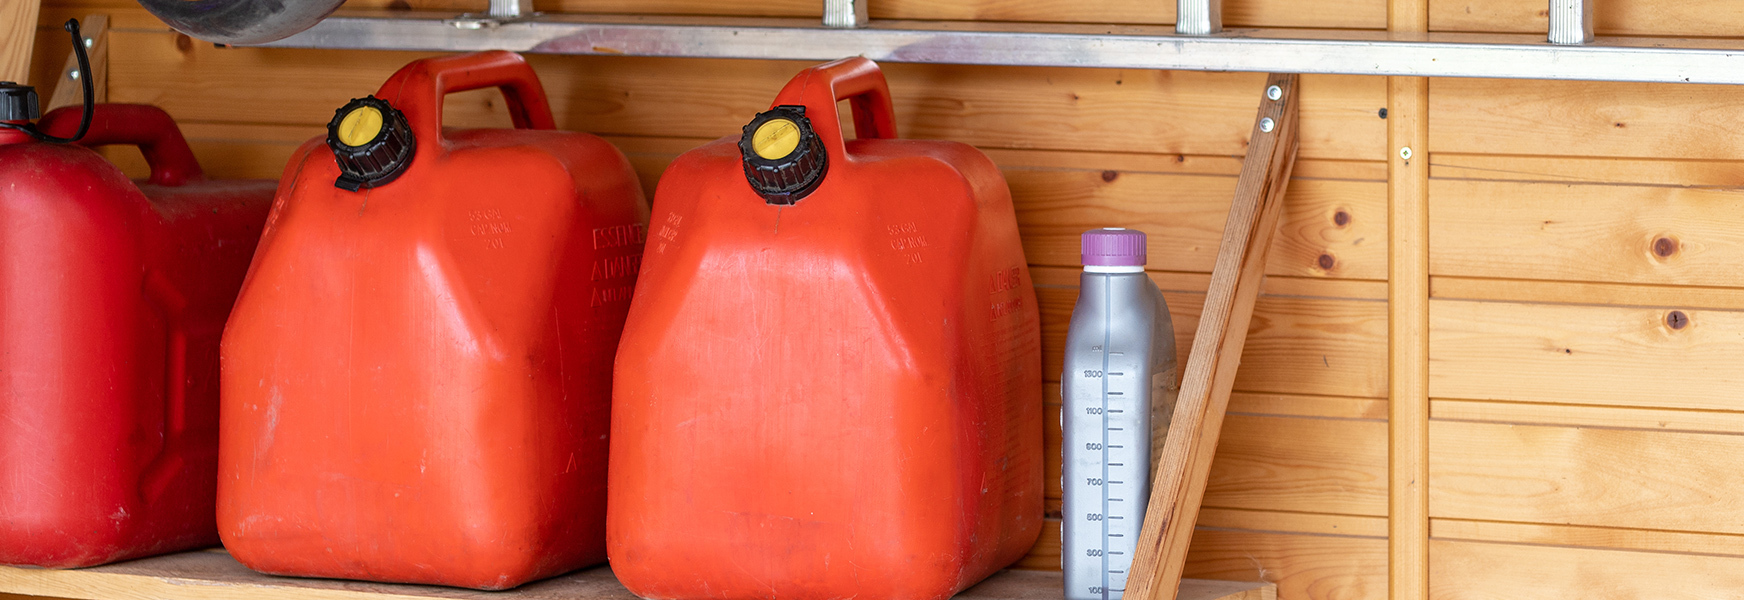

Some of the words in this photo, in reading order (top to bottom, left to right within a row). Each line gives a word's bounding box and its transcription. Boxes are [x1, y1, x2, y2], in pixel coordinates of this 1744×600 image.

[1083, 369, 1103, 379] 1300
[1085, 406, 1103, 416] 1100
[1086, 477, 1103, 486] 700
[1086, 548, 1103, 557] 300
[1087, 586, 1103, 595] 100
